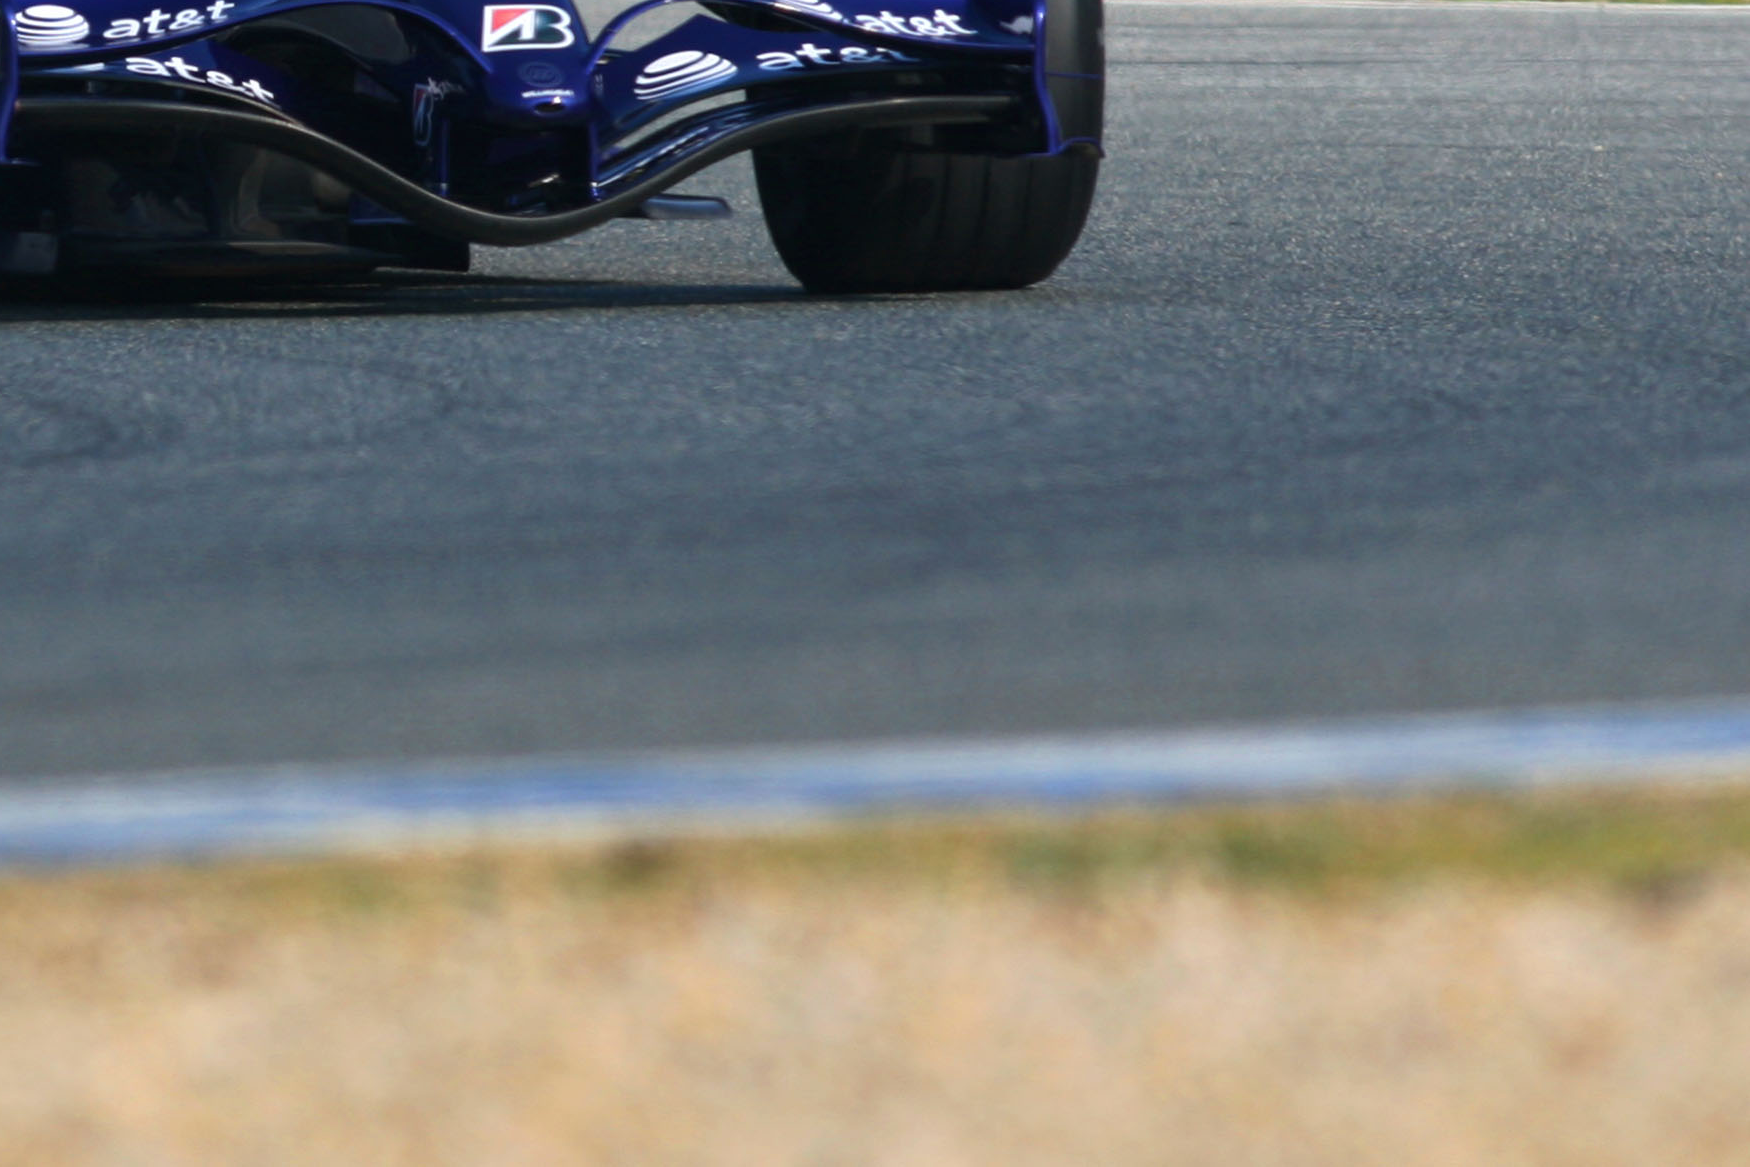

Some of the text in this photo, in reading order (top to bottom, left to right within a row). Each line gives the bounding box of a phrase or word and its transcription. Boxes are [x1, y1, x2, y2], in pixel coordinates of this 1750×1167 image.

[103, 0, 235, 39] at&t
[855, 9, 979, 38] at&t
[123, 56, 281, 100] at&t
